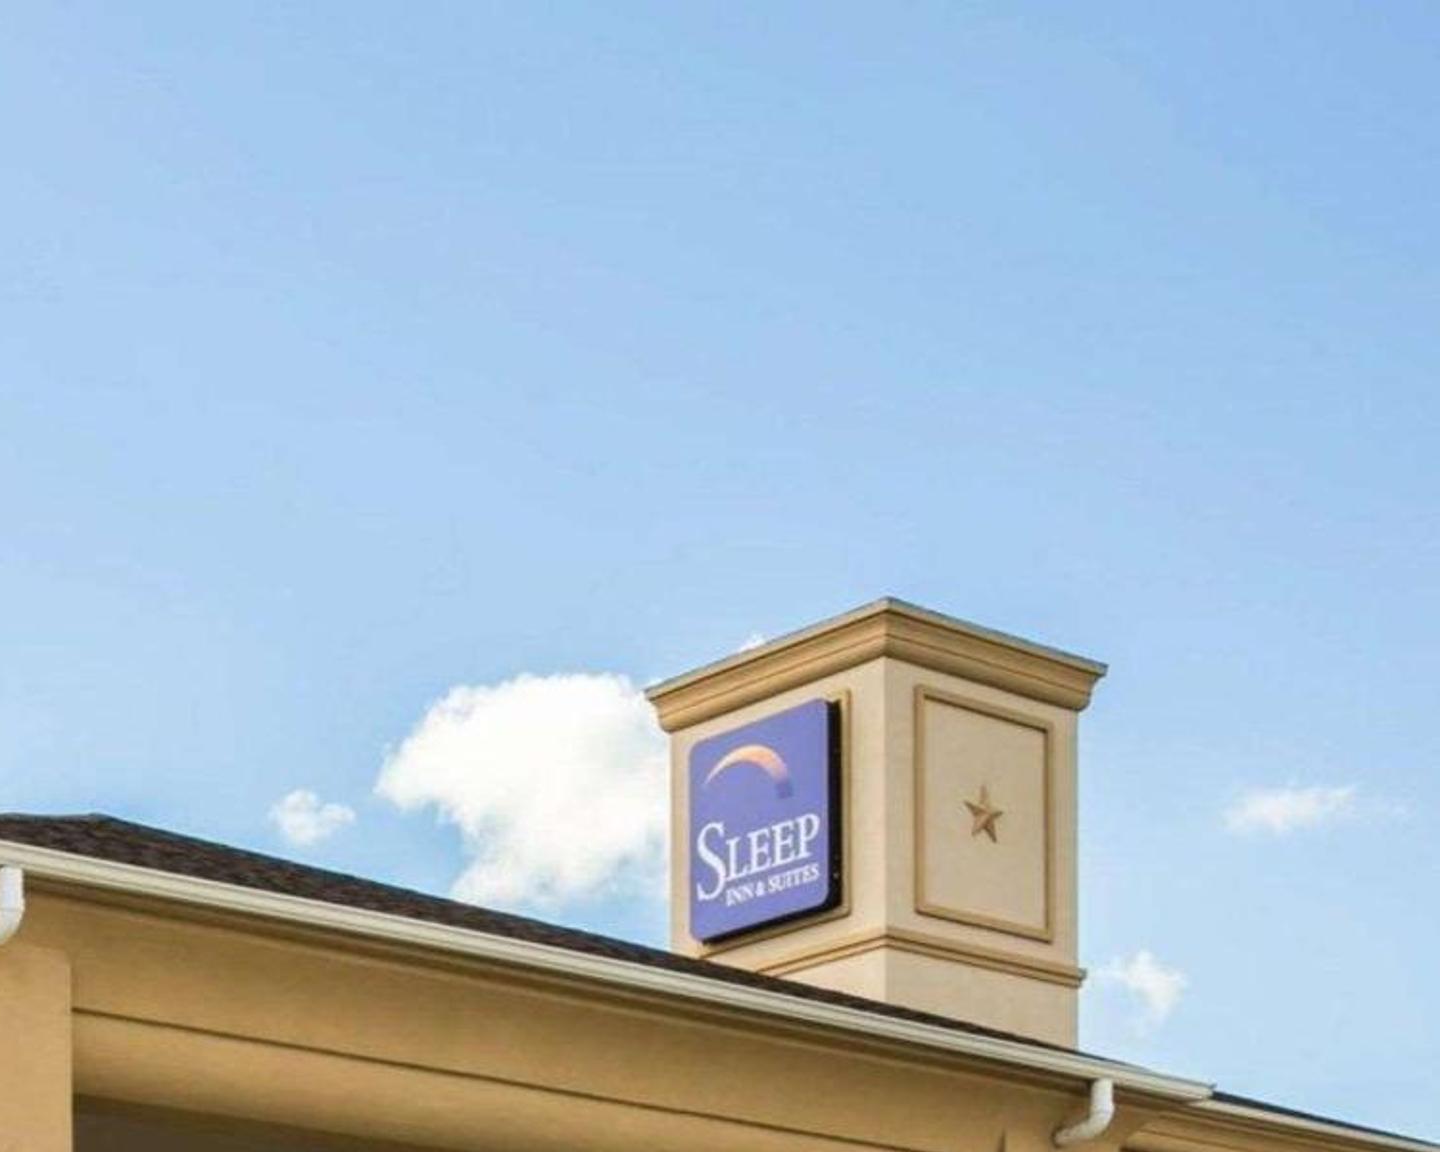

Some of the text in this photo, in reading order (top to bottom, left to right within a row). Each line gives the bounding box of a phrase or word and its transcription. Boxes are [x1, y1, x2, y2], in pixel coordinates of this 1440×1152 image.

[697, 813, 820, 901] SLEEP
[725, 863, 820, 907] INN & SUITES
